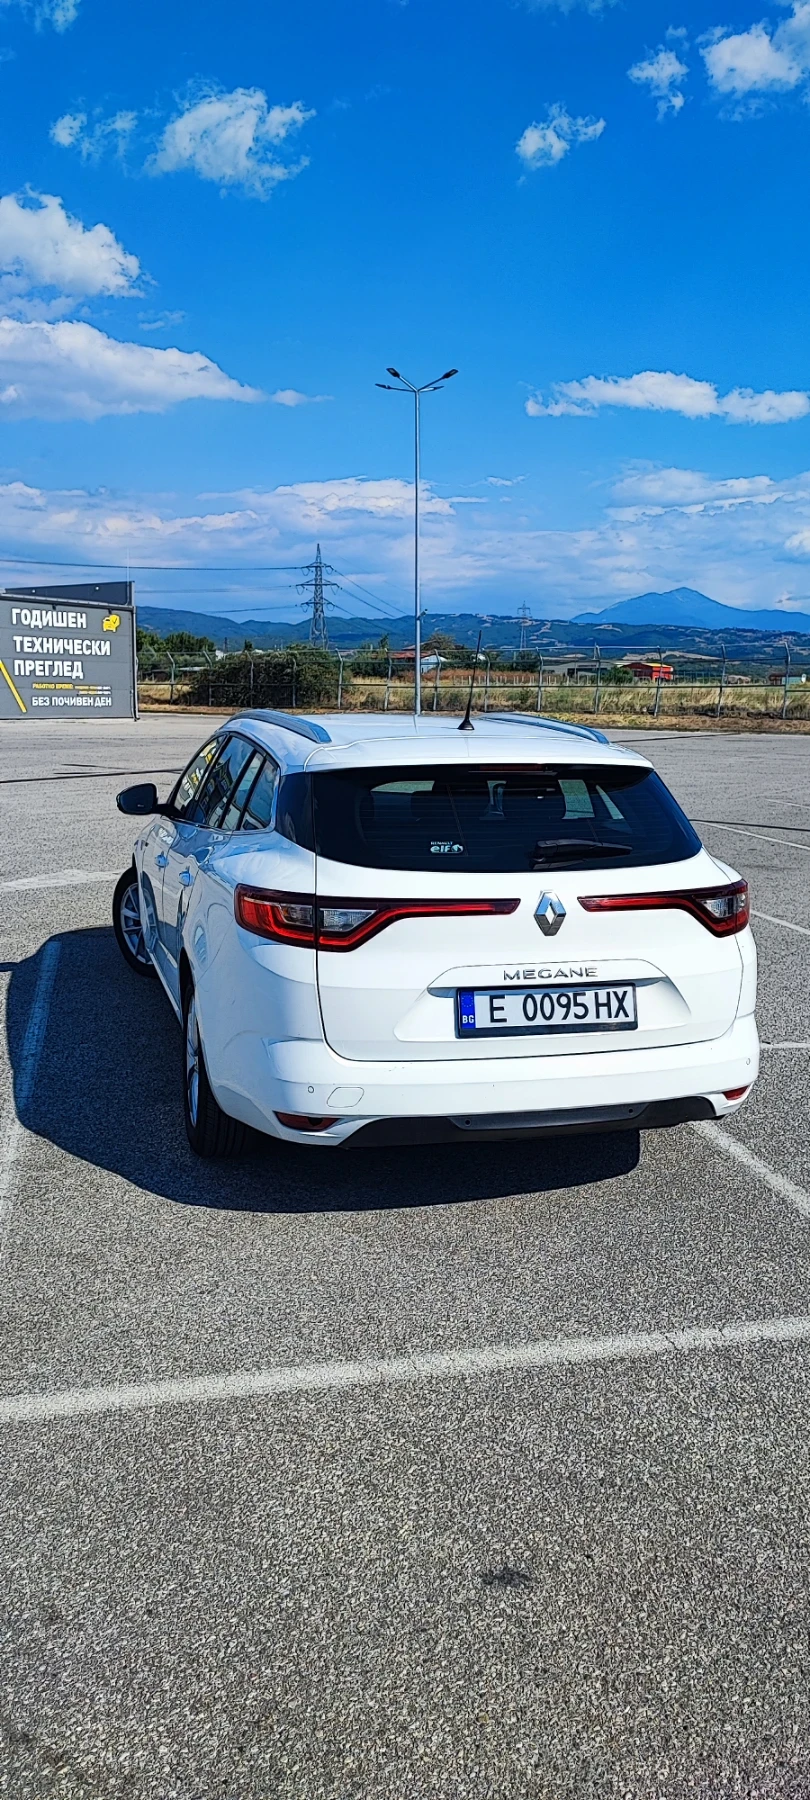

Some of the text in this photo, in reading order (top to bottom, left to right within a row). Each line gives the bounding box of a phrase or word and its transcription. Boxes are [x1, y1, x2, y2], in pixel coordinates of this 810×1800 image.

[12, 608, 87, 629] ГОДИШЕН
[13, 636, 111, 656] ТЕХНИЧЕСКИ
[14, 659, 84, 679] ПРЕГЛЕД
[32, 697, 112, 707] БЕЗ ПОЧИВЕН ДЕН
[503, 967, 598, 981] MEGANE
[489, 990, 630, 1023] E 0095 HX
[462, 1015, 475, 1024] BG
